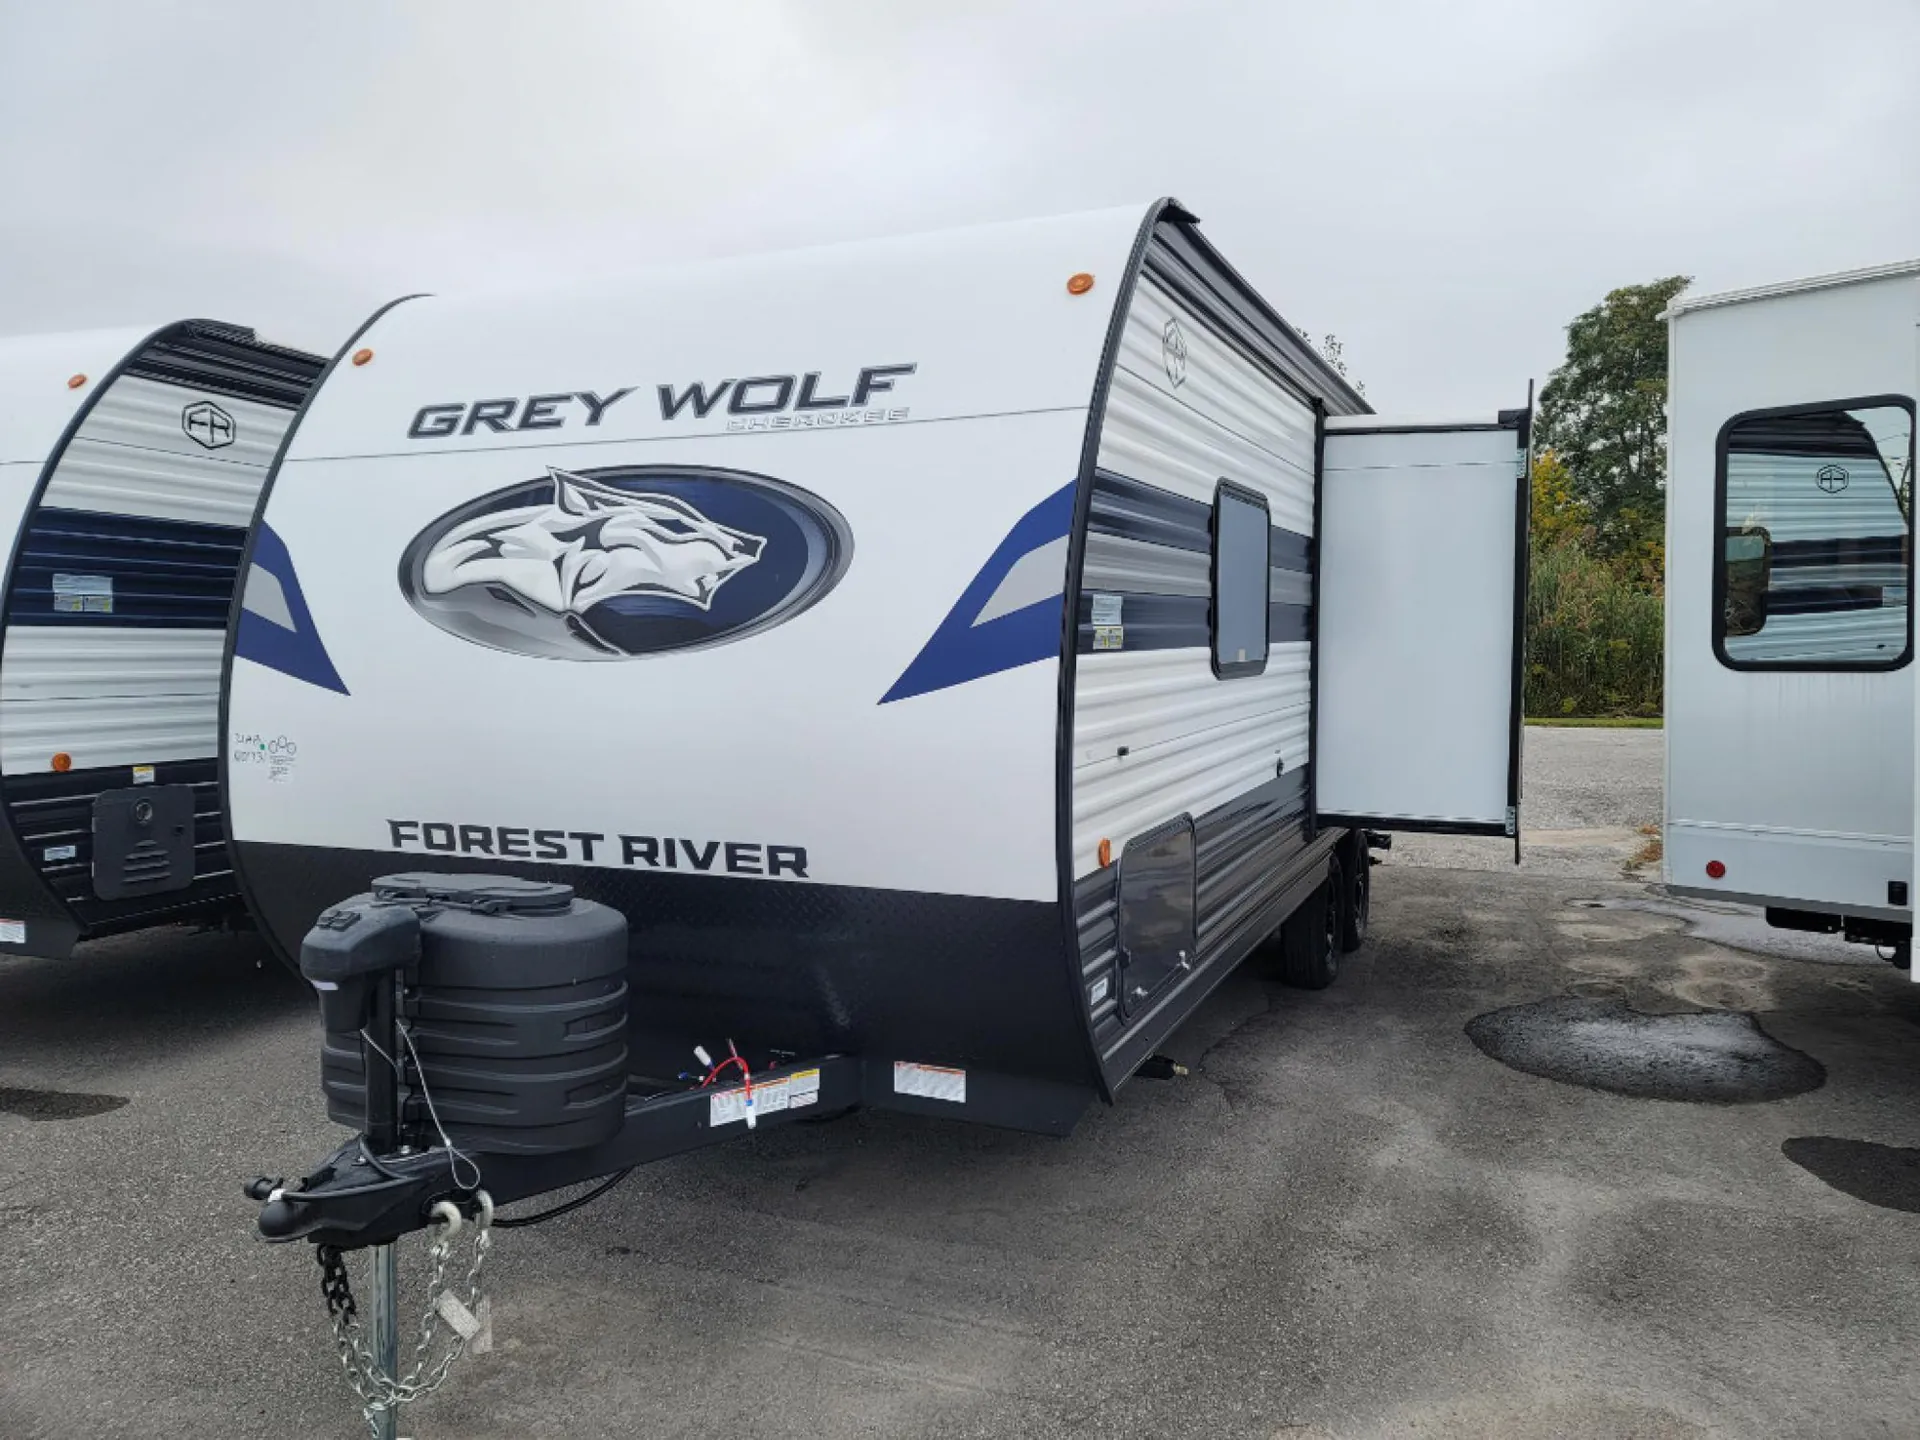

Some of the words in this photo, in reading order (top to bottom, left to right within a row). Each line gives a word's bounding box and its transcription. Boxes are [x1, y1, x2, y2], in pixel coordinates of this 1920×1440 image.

[408, 386, 639, 439] GREY
[657, 363, 917, 421] WOLF
[726, 406, 911, 431] CHEROKEE
[387, 818, 605, 861] FOREST
[619, 834, 810, 878] RIVER
